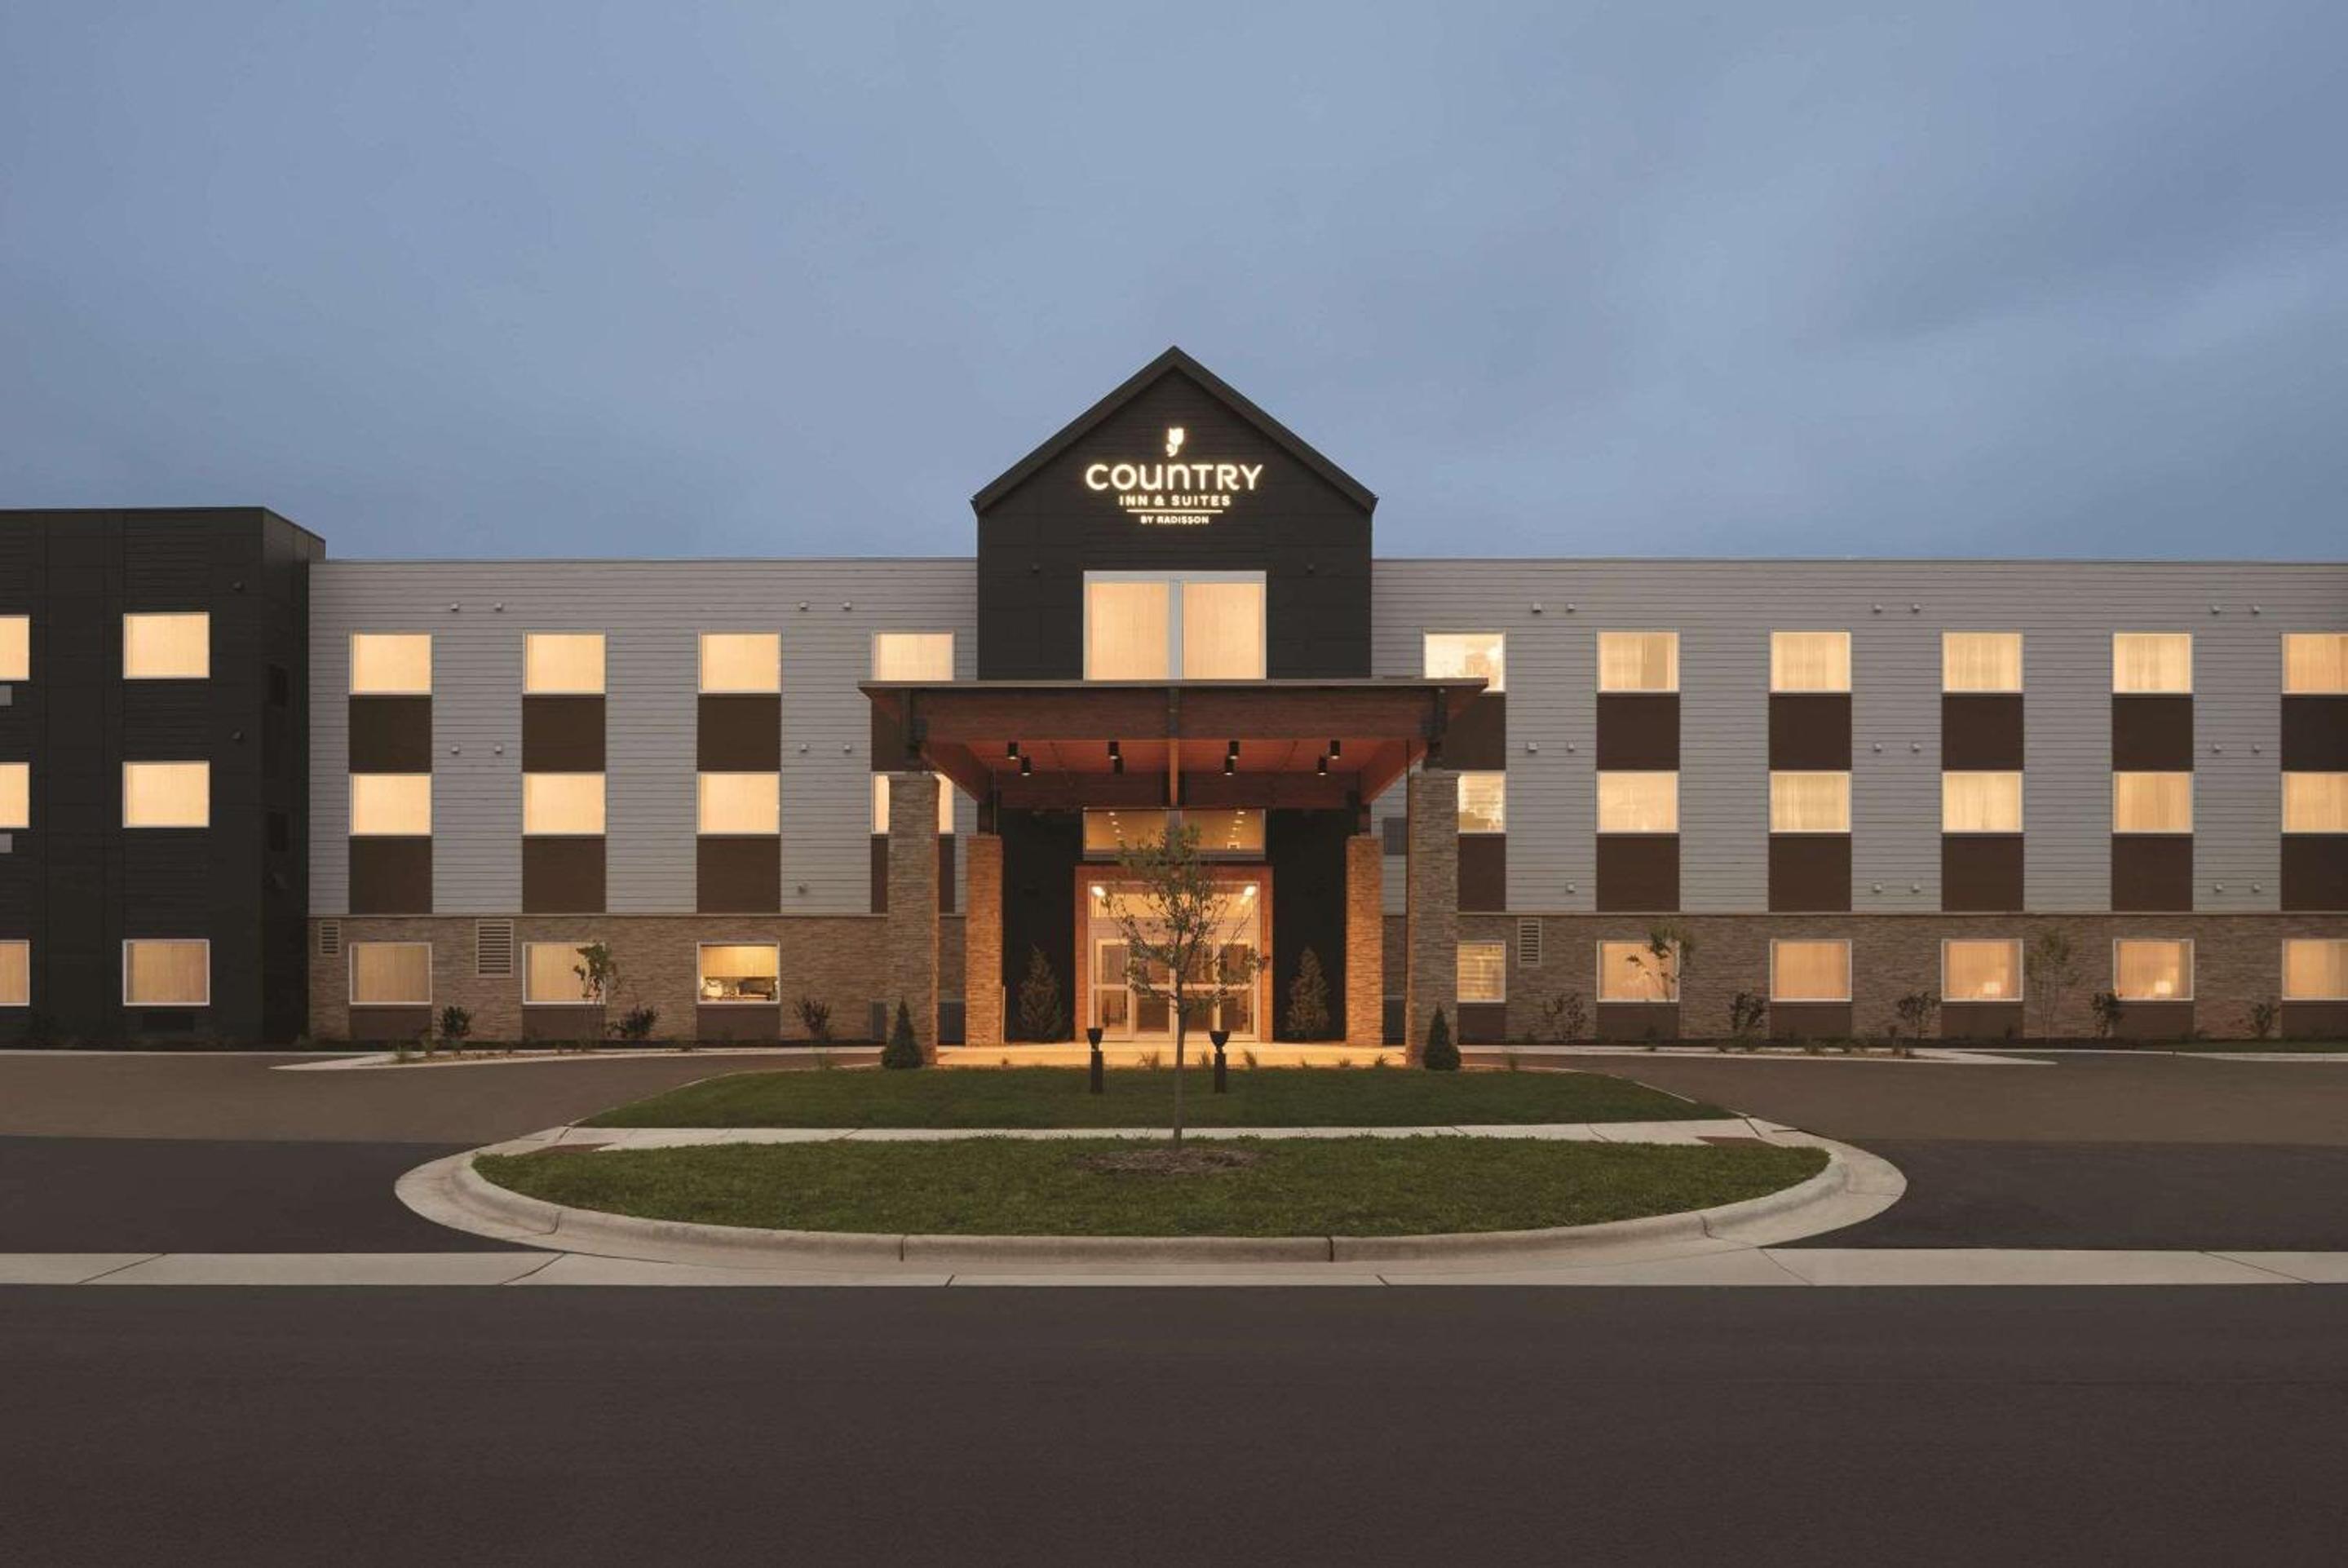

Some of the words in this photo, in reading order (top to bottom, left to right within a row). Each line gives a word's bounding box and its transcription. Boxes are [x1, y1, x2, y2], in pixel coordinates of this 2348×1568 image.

[1119, 495, 1147, 506] INN
[1154, 495, 1165, 506] &
[1171, 495, 1231, 506] SUITES
[1140, 515, 1153, 524] BY
[1156, 515, 1209, 524] RADISSON
